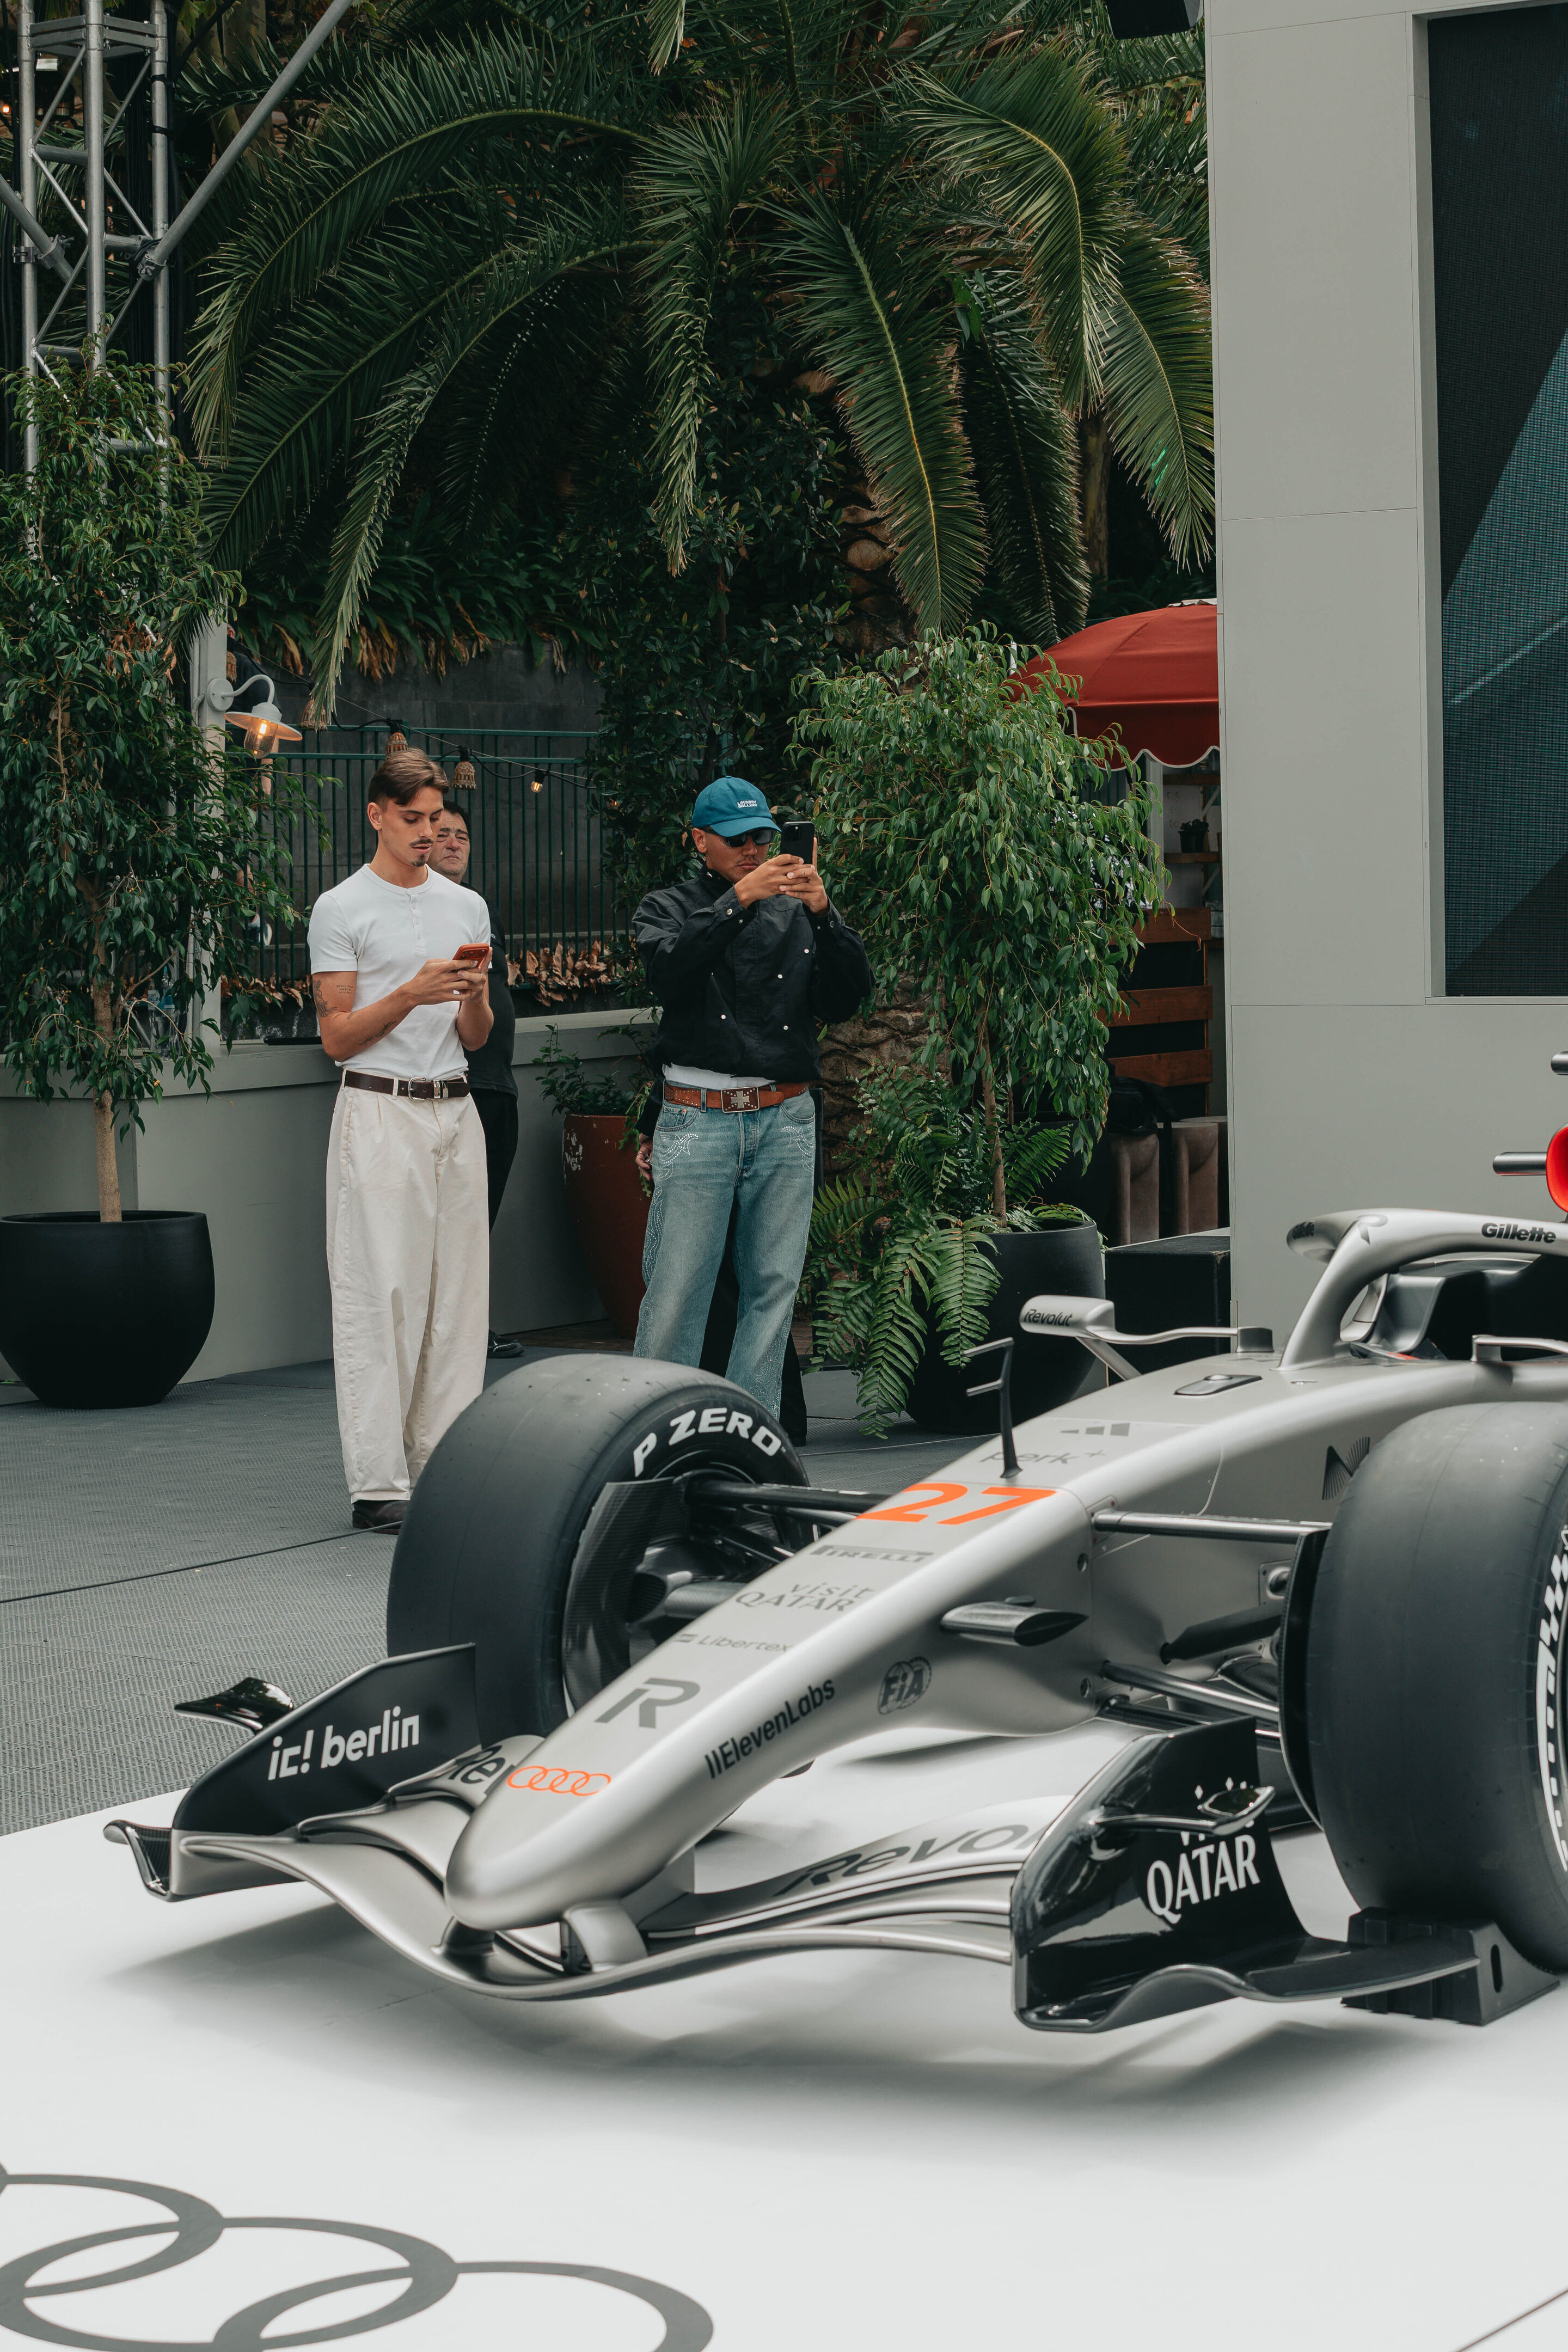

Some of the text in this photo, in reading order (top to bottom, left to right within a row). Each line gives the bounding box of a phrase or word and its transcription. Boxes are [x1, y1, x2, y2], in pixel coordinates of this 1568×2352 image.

[1481, 1222, 1556, 1244] Gillette
[1024, 1309, 1073, 1326] Revolut
[633, 1407, 782, 1477] P ZERO
[854, 1483, 1057, 1525] 27
[810, 1545, 934, 1563] PIRELLI
[735, 1591, 854, 1612] QATAR
[791, 1582, 874, 1600] visit
[697, 1634, 794, 1652] Libertex
[268, 1705, 420, 1781] ic! berlin
[1147, 1834, 1261, 1925] QATAR
